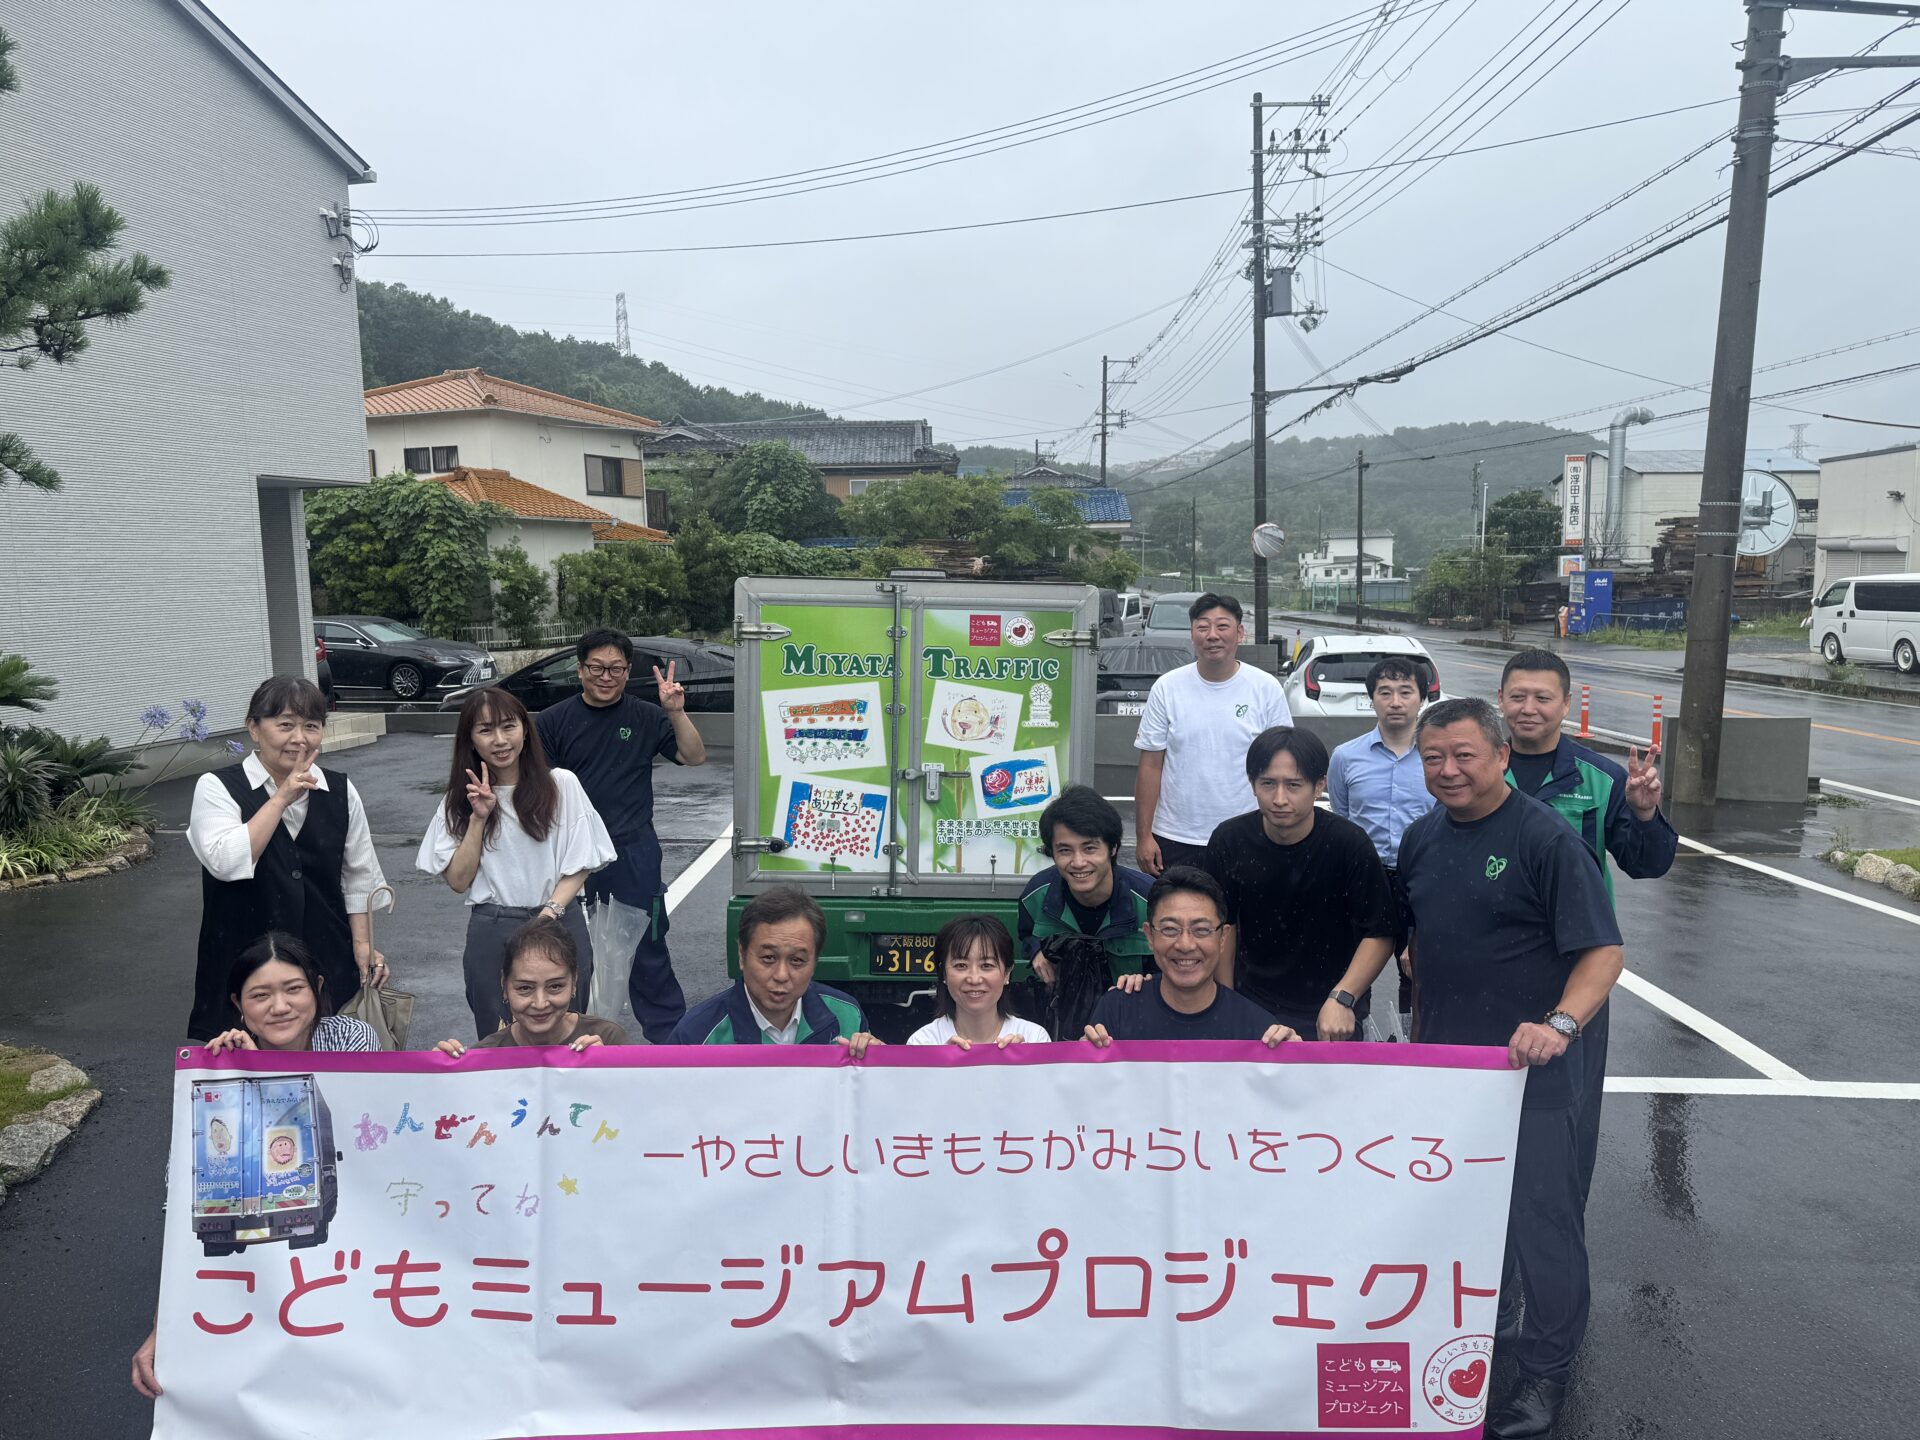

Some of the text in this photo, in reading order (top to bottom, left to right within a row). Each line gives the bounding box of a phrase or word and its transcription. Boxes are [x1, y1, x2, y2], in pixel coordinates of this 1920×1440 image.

[922, 646, 1060, 681] TRAFFIC
[811, 797, 858, 814] ありがとう
[937, 820, 1038, 829] 未来を創造し将来世代を
[937, 828, 1038, 837] 子供たちのアートを募集
[888, 949, 935, 973] 31-6
[385, 1177, 540, 1218] 守ってね
[192, 1228, 1498, 1337] こどもミュージアムプロジェクト
[1325, 1357, 1366, 1372] こども
[1325, 1379, 1404, 1393] ミュージアム
[1325, 1399, 1404, 1415] プロジェクト
